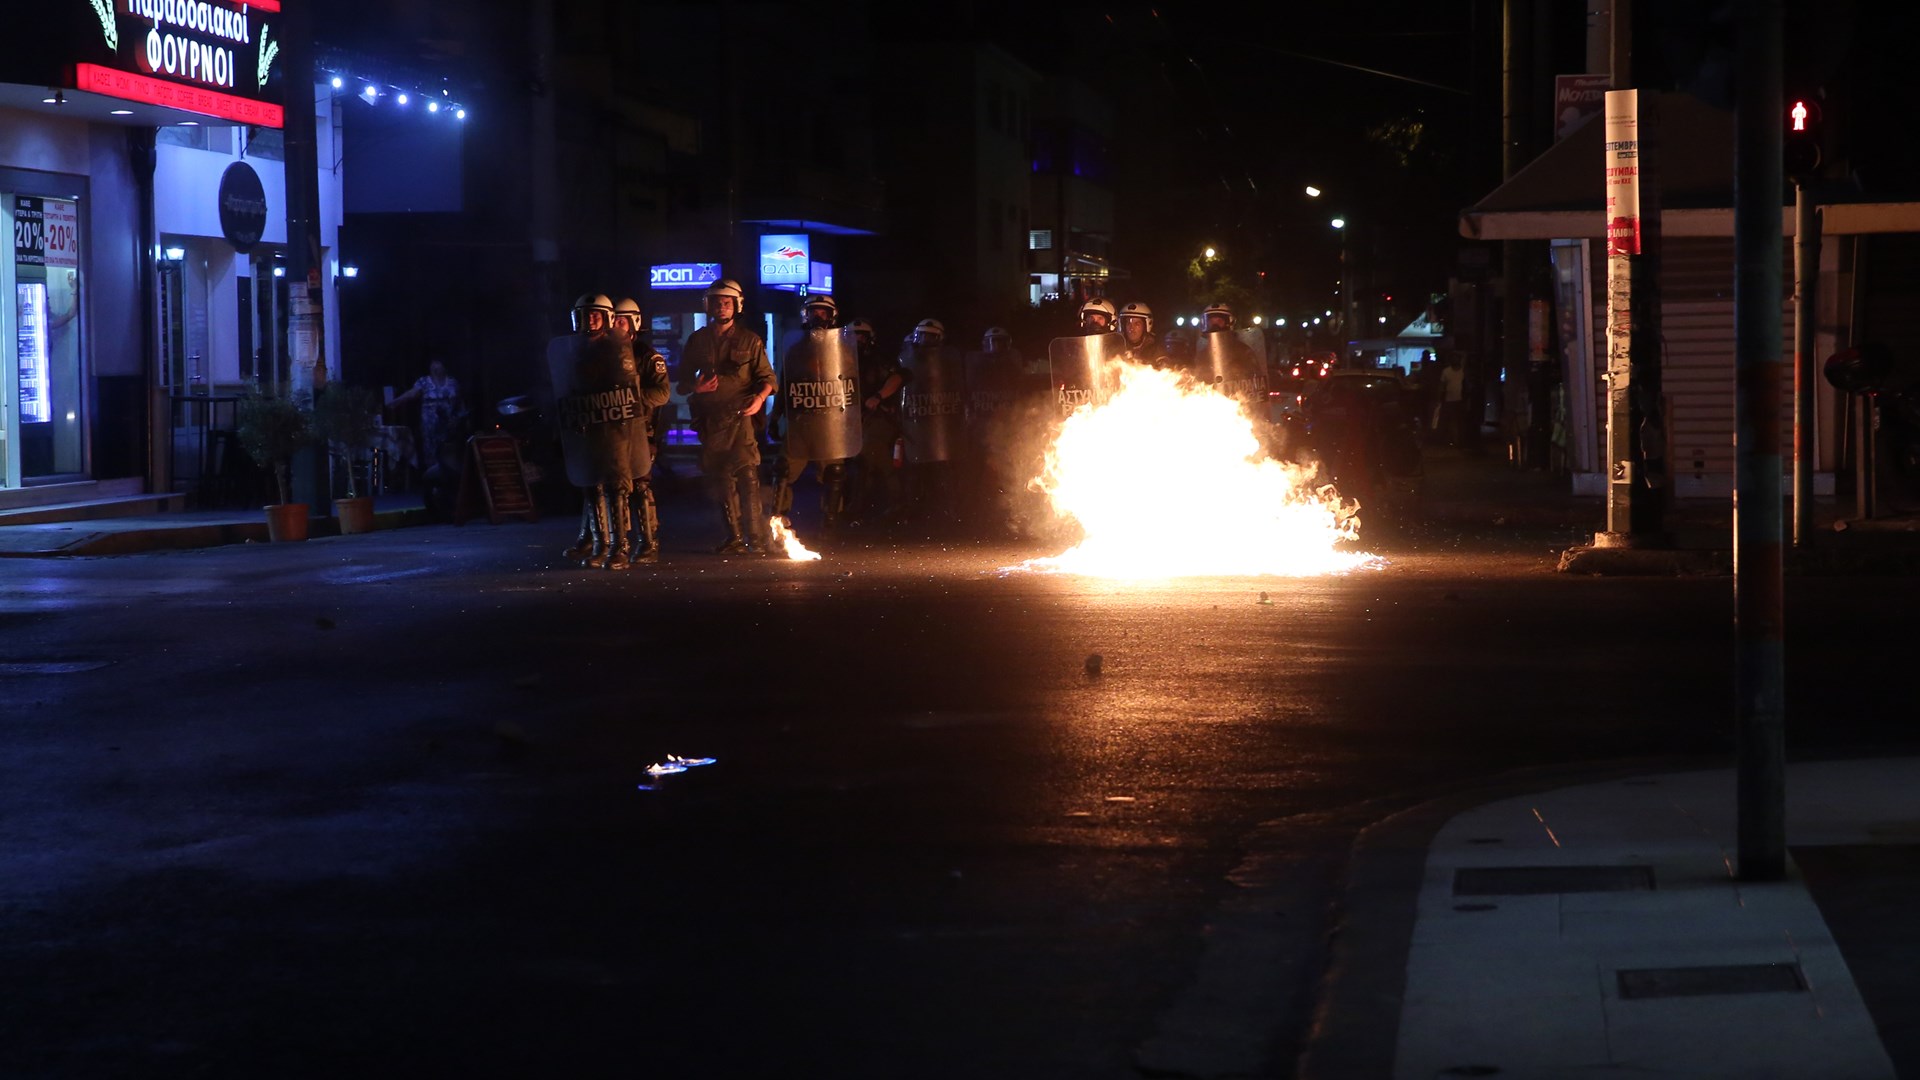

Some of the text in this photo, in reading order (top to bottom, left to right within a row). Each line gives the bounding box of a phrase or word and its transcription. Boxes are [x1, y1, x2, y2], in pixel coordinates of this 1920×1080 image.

[147, 28, 233, 87] ΦΟΥΡΝΟΙ
[45, 224, 77, 252] -20%
[789, 379, 855, 397] ΑΣΤΥΝΟΜΙΑ
[793, 393, 853, 409] POLICE
[908, 403, 960, 417] POLICE
